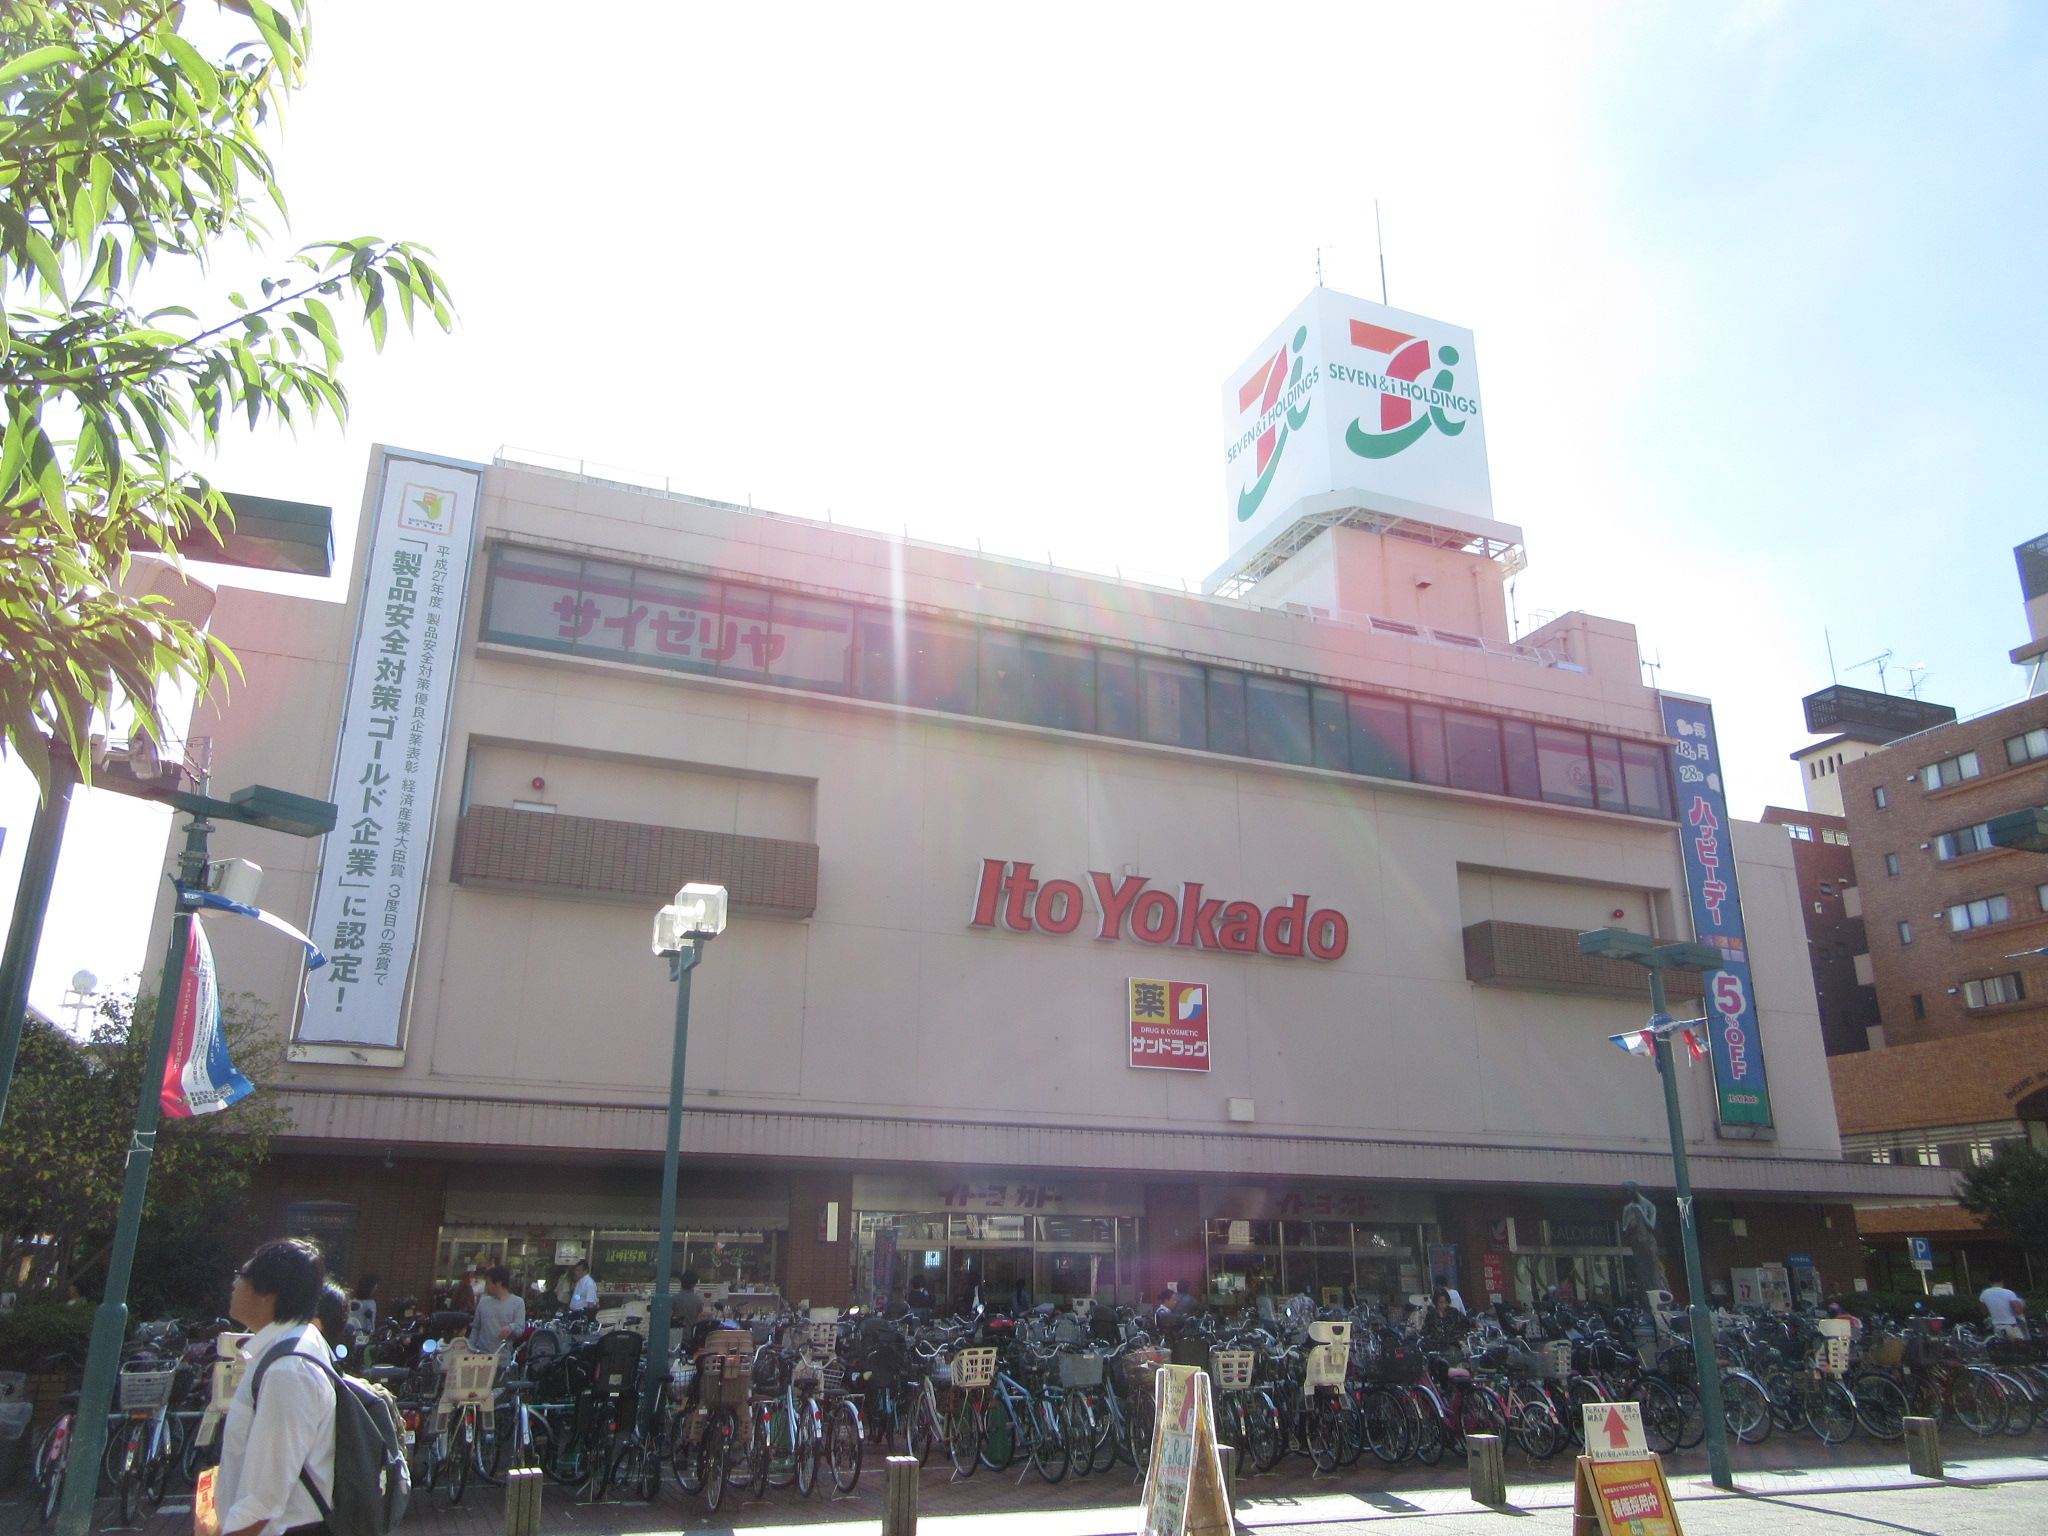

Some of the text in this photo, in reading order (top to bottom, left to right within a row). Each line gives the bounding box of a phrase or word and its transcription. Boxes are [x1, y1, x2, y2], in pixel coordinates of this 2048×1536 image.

[1268, 365, 1320, 426] HOLDINGS
[1400, 383, 1477, 415] HOLDINGS
[553, 594, 785, 668] サイゼリヤ
[1688, 796, 1727, 926] ハッピーデー
[1134, 982, 1165, 1018] 薬
[1132, 1036, 1208, 1057] サンドラッグ
[1140, 1026, 1159, 1034] DRUG
[1166, 1028, 1199, 1036] COSMETIC
[605, 1248, 648, 1263] 証明写真
[1915, 1240, 1926, 1258] P
